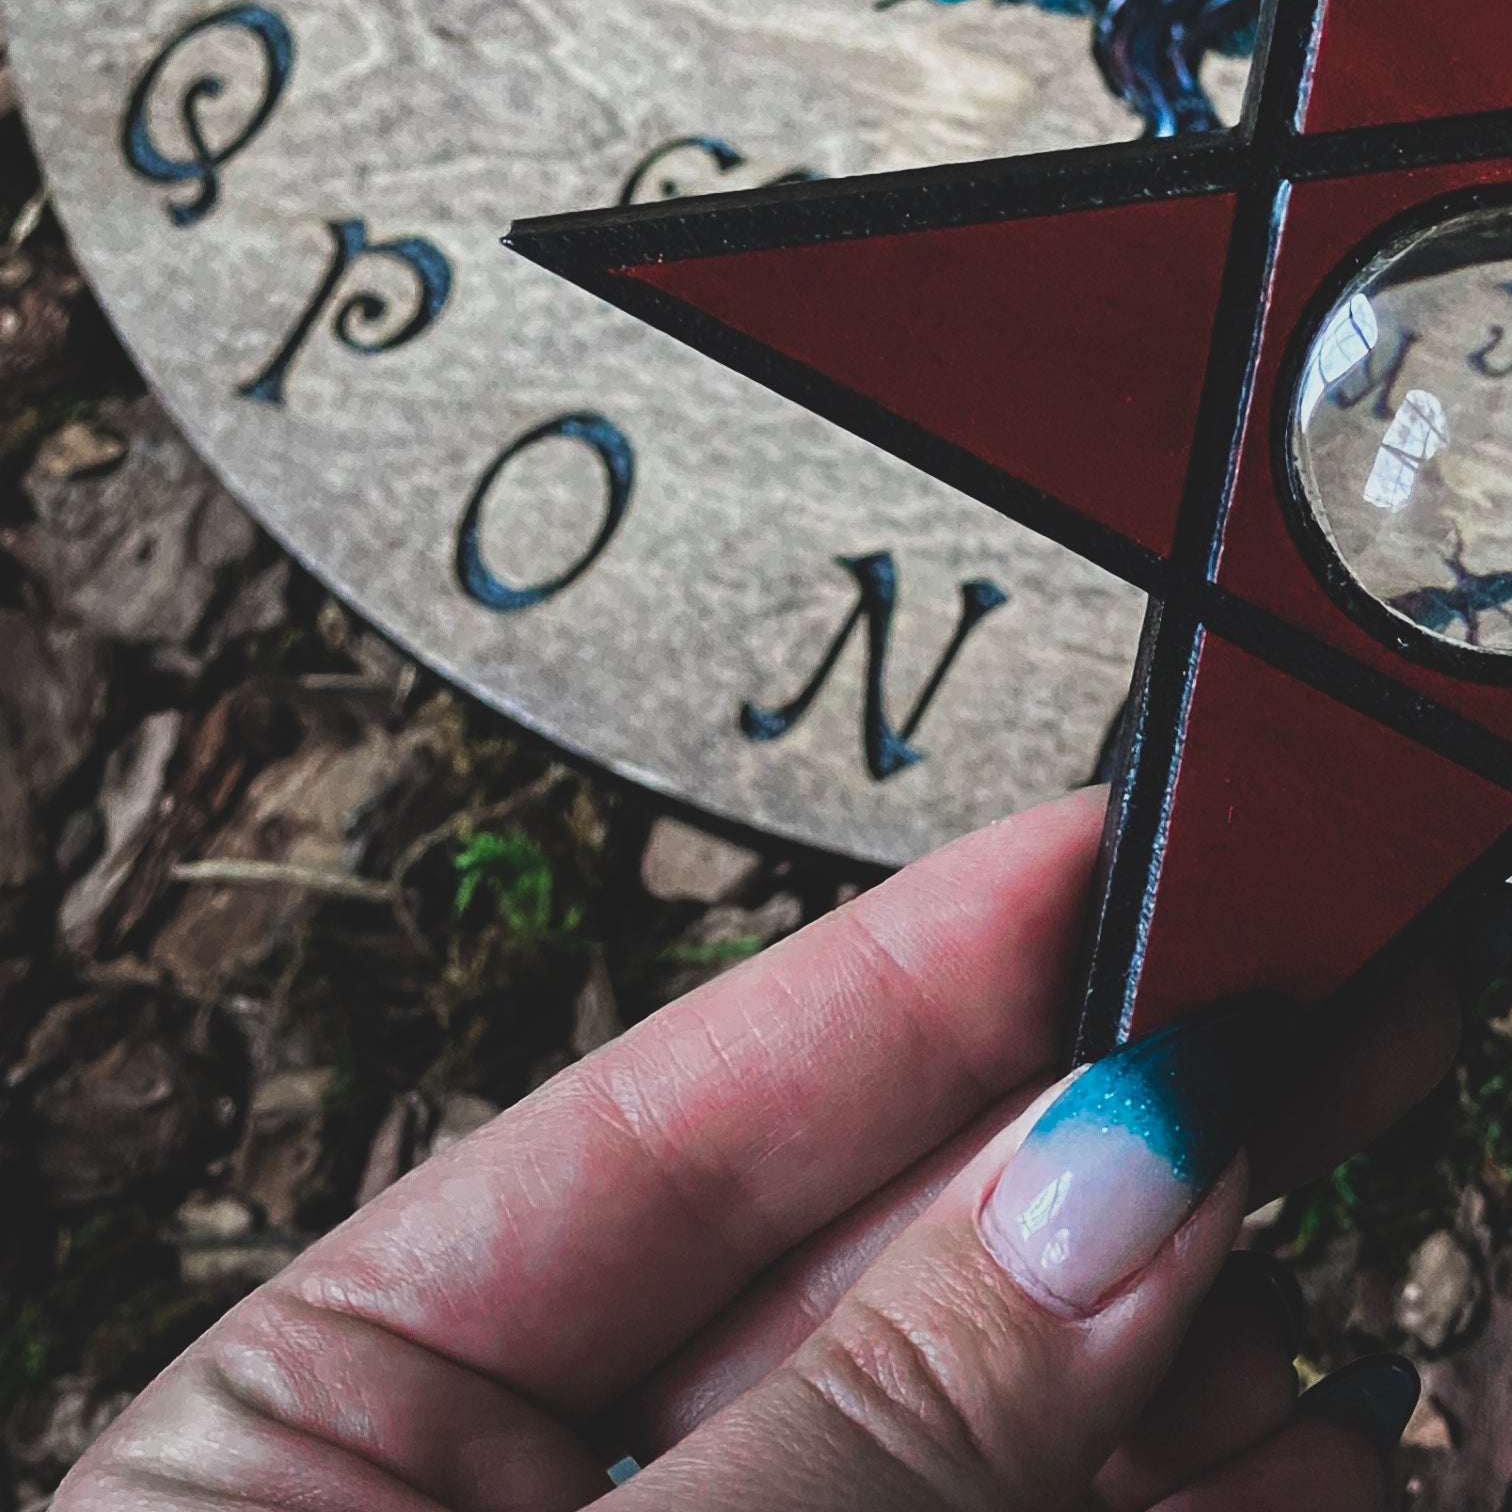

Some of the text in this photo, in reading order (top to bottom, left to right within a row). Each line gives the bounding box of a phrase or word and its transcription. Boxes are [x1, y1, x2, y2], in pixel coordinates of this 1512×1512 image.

[115, 0, 296, 230] Q
[237, 219, 454, 404] P
[449, 408, 636, 617] O
[732, 550, 1008, 784] N
